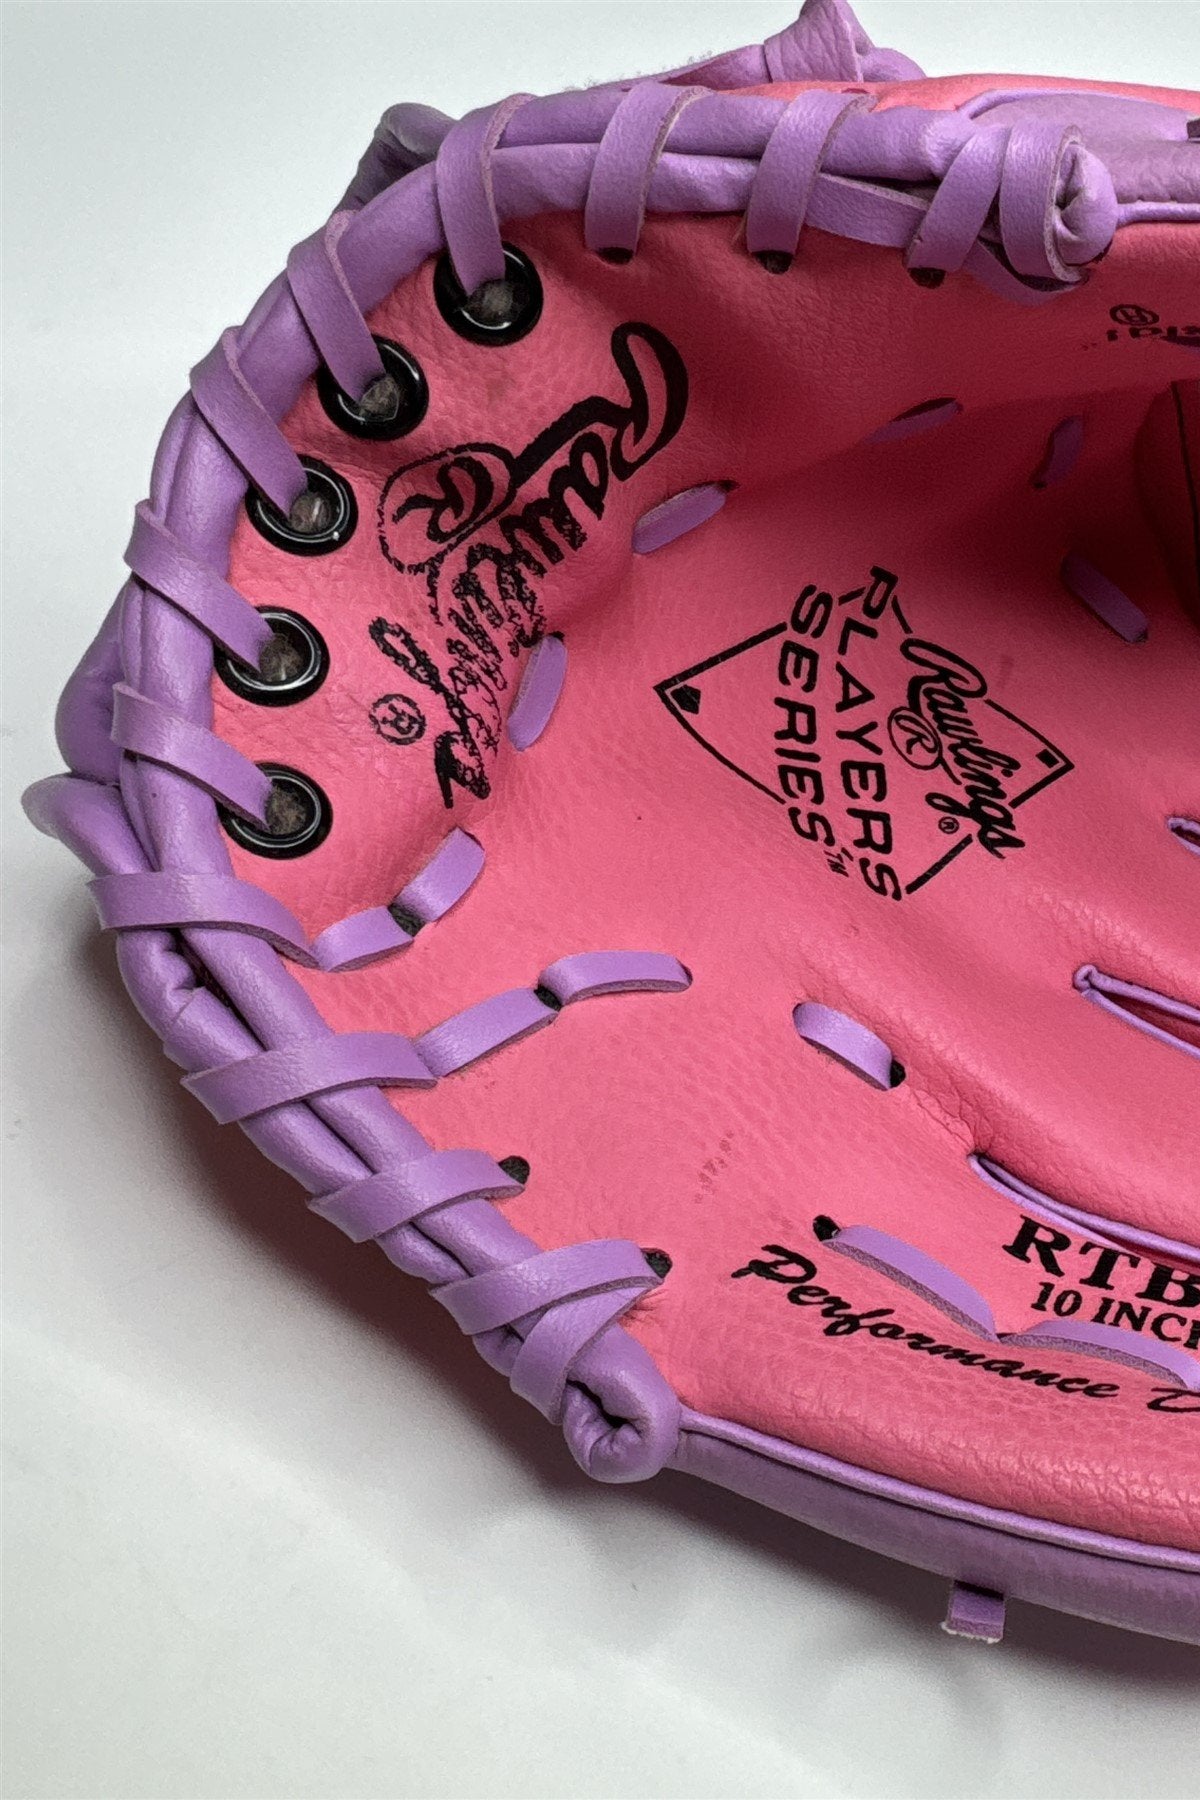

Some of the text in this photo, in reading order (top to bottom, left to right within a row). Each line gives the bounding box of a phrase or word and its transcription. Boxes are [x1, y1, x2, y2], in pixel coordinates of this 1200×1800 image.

[368, 321, 689, 809] Rawlings
[836, 565, 902, 902] PLAYERS
[887, 637, 1026, 860] Rawlings
[730, 1243, 1122, 1400] Performance
[1031, 1280, 1084, 1319] 10
